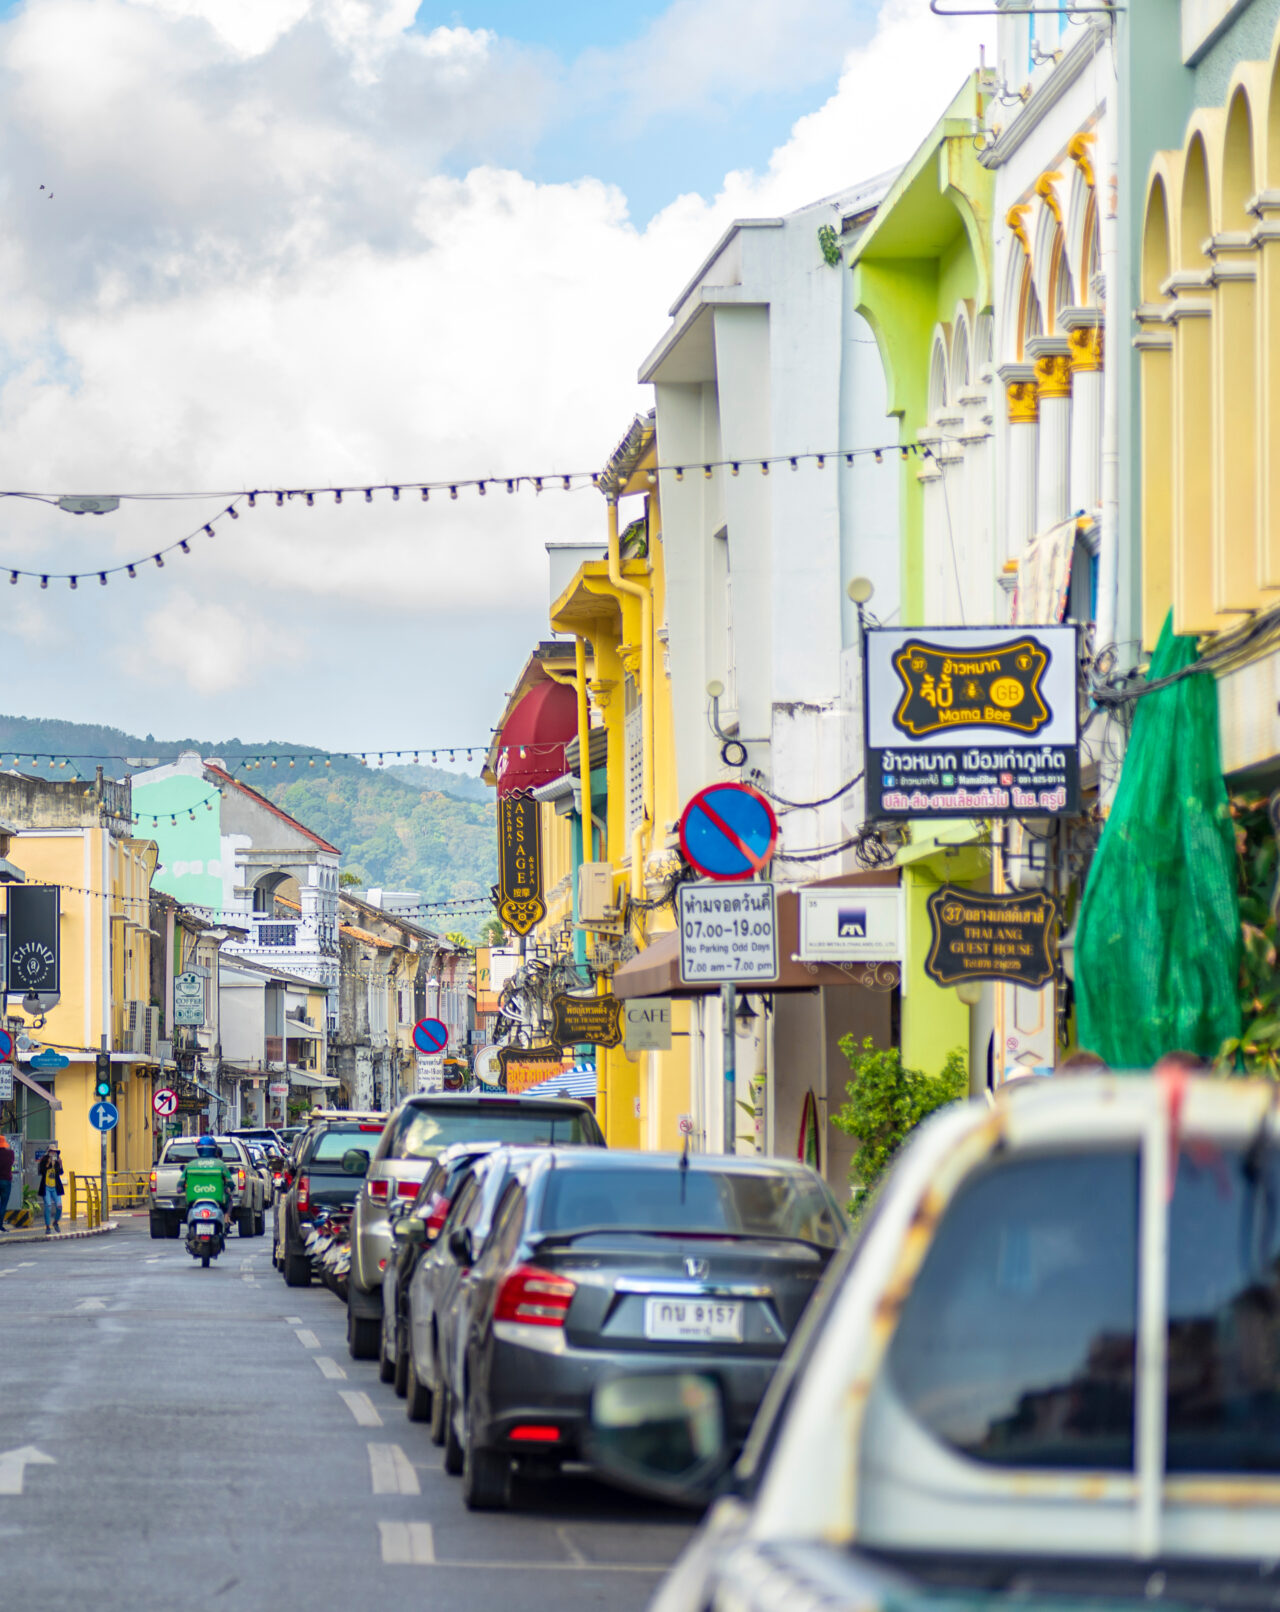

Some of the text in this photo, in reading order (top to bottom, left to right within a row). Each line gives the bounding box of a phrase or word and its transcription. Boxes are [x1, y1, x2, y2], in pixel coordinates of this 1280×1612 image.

[942, 658, 1001, 675] ข้าวหมาก
[996, 685, 1019, 701] GB
[938, 705, 1012, 723] Mama Bee
[882, 747, 1066, 773] ข้าวหมาก เมืองเก่าภูเก็ต
[514, 803, 526, 884] ASSAGE
[685, 887, 770, 914] ห้ามจอดวันคี่
[946, 906, 962, 921] 37
[685, 919, 771, 939] 07.00-19.00
[964, 927, 1023, 940] THALANG
[12, 941, 55, 964] CHINO
[685, 942, 770, 954] No Parking Odd Days
[950, 941, 1034, 956] GUEST HOUSE
[687, 959, 707, 973] 7.00
[757, 962, 772, 972] pm
[627, 1008, 669, 1024] CAFE
[194, 1184, 217, 1193] Grab
[695, 1306, 736, 1323] 9157
